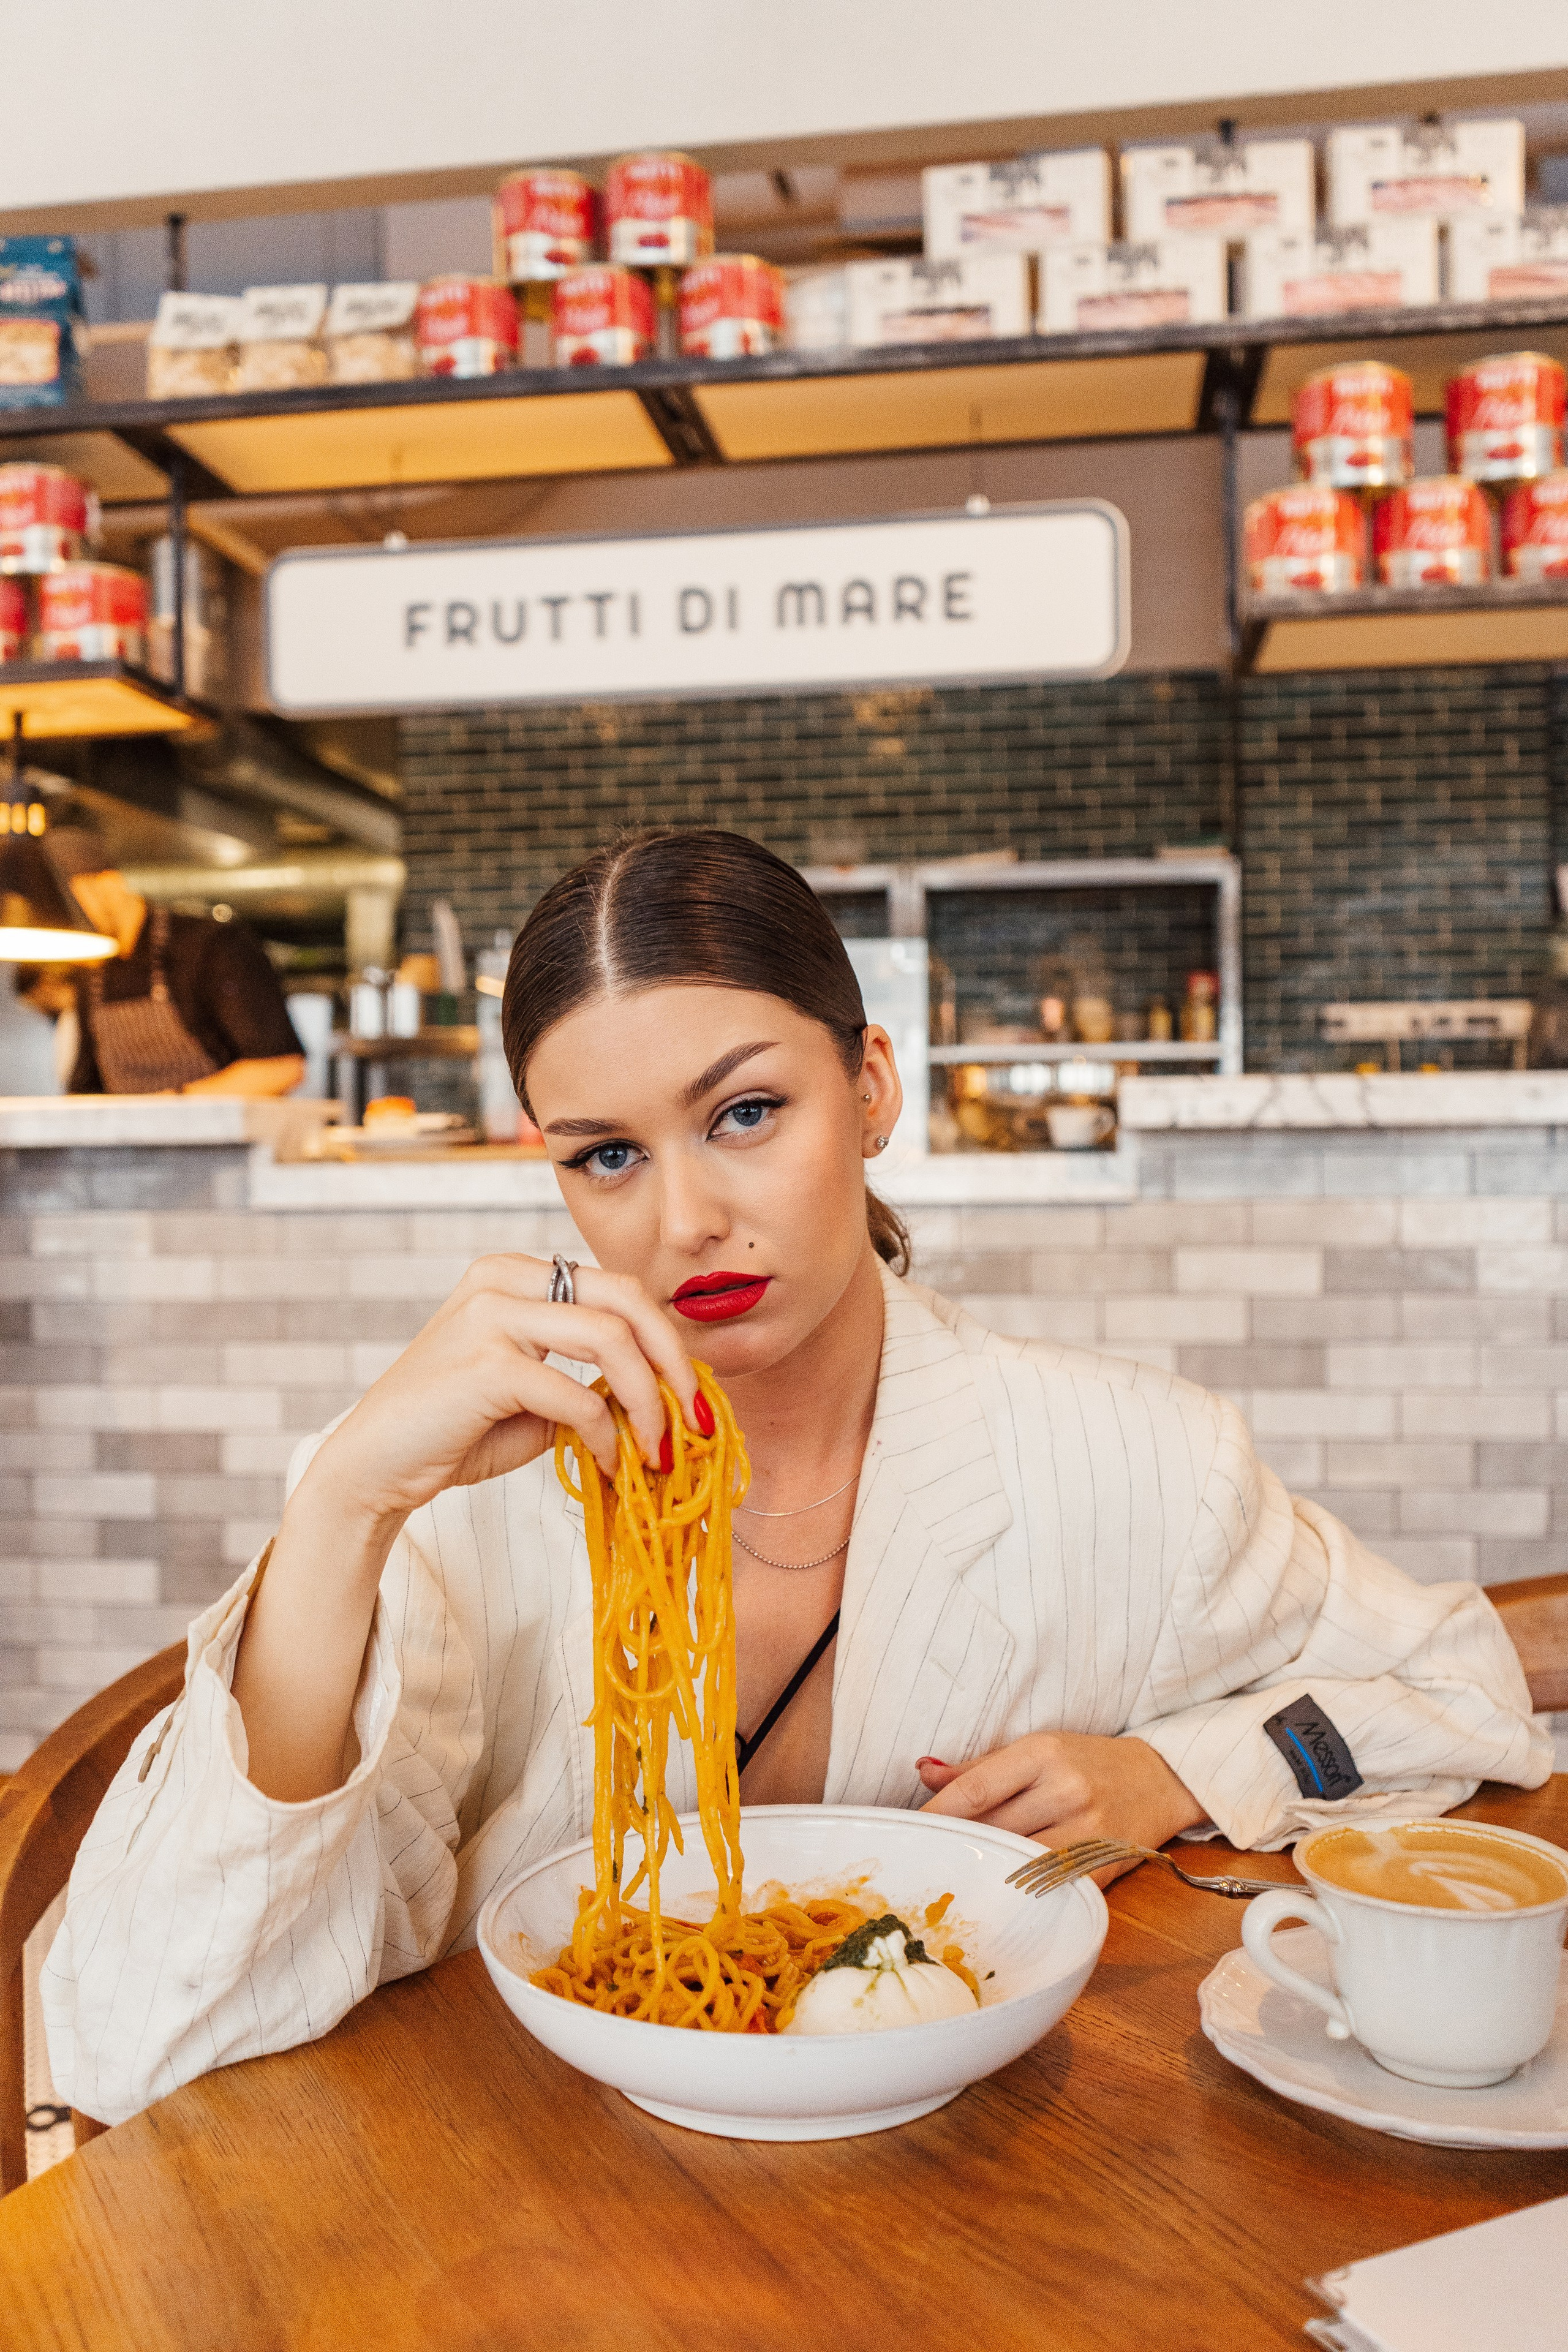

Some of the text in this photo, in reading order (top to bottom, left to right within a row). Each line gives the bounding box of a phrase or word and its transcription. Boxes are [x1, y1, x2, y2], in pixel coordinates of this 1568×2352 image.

[404, 571, 973, 647] FRUTTI DI MARE
